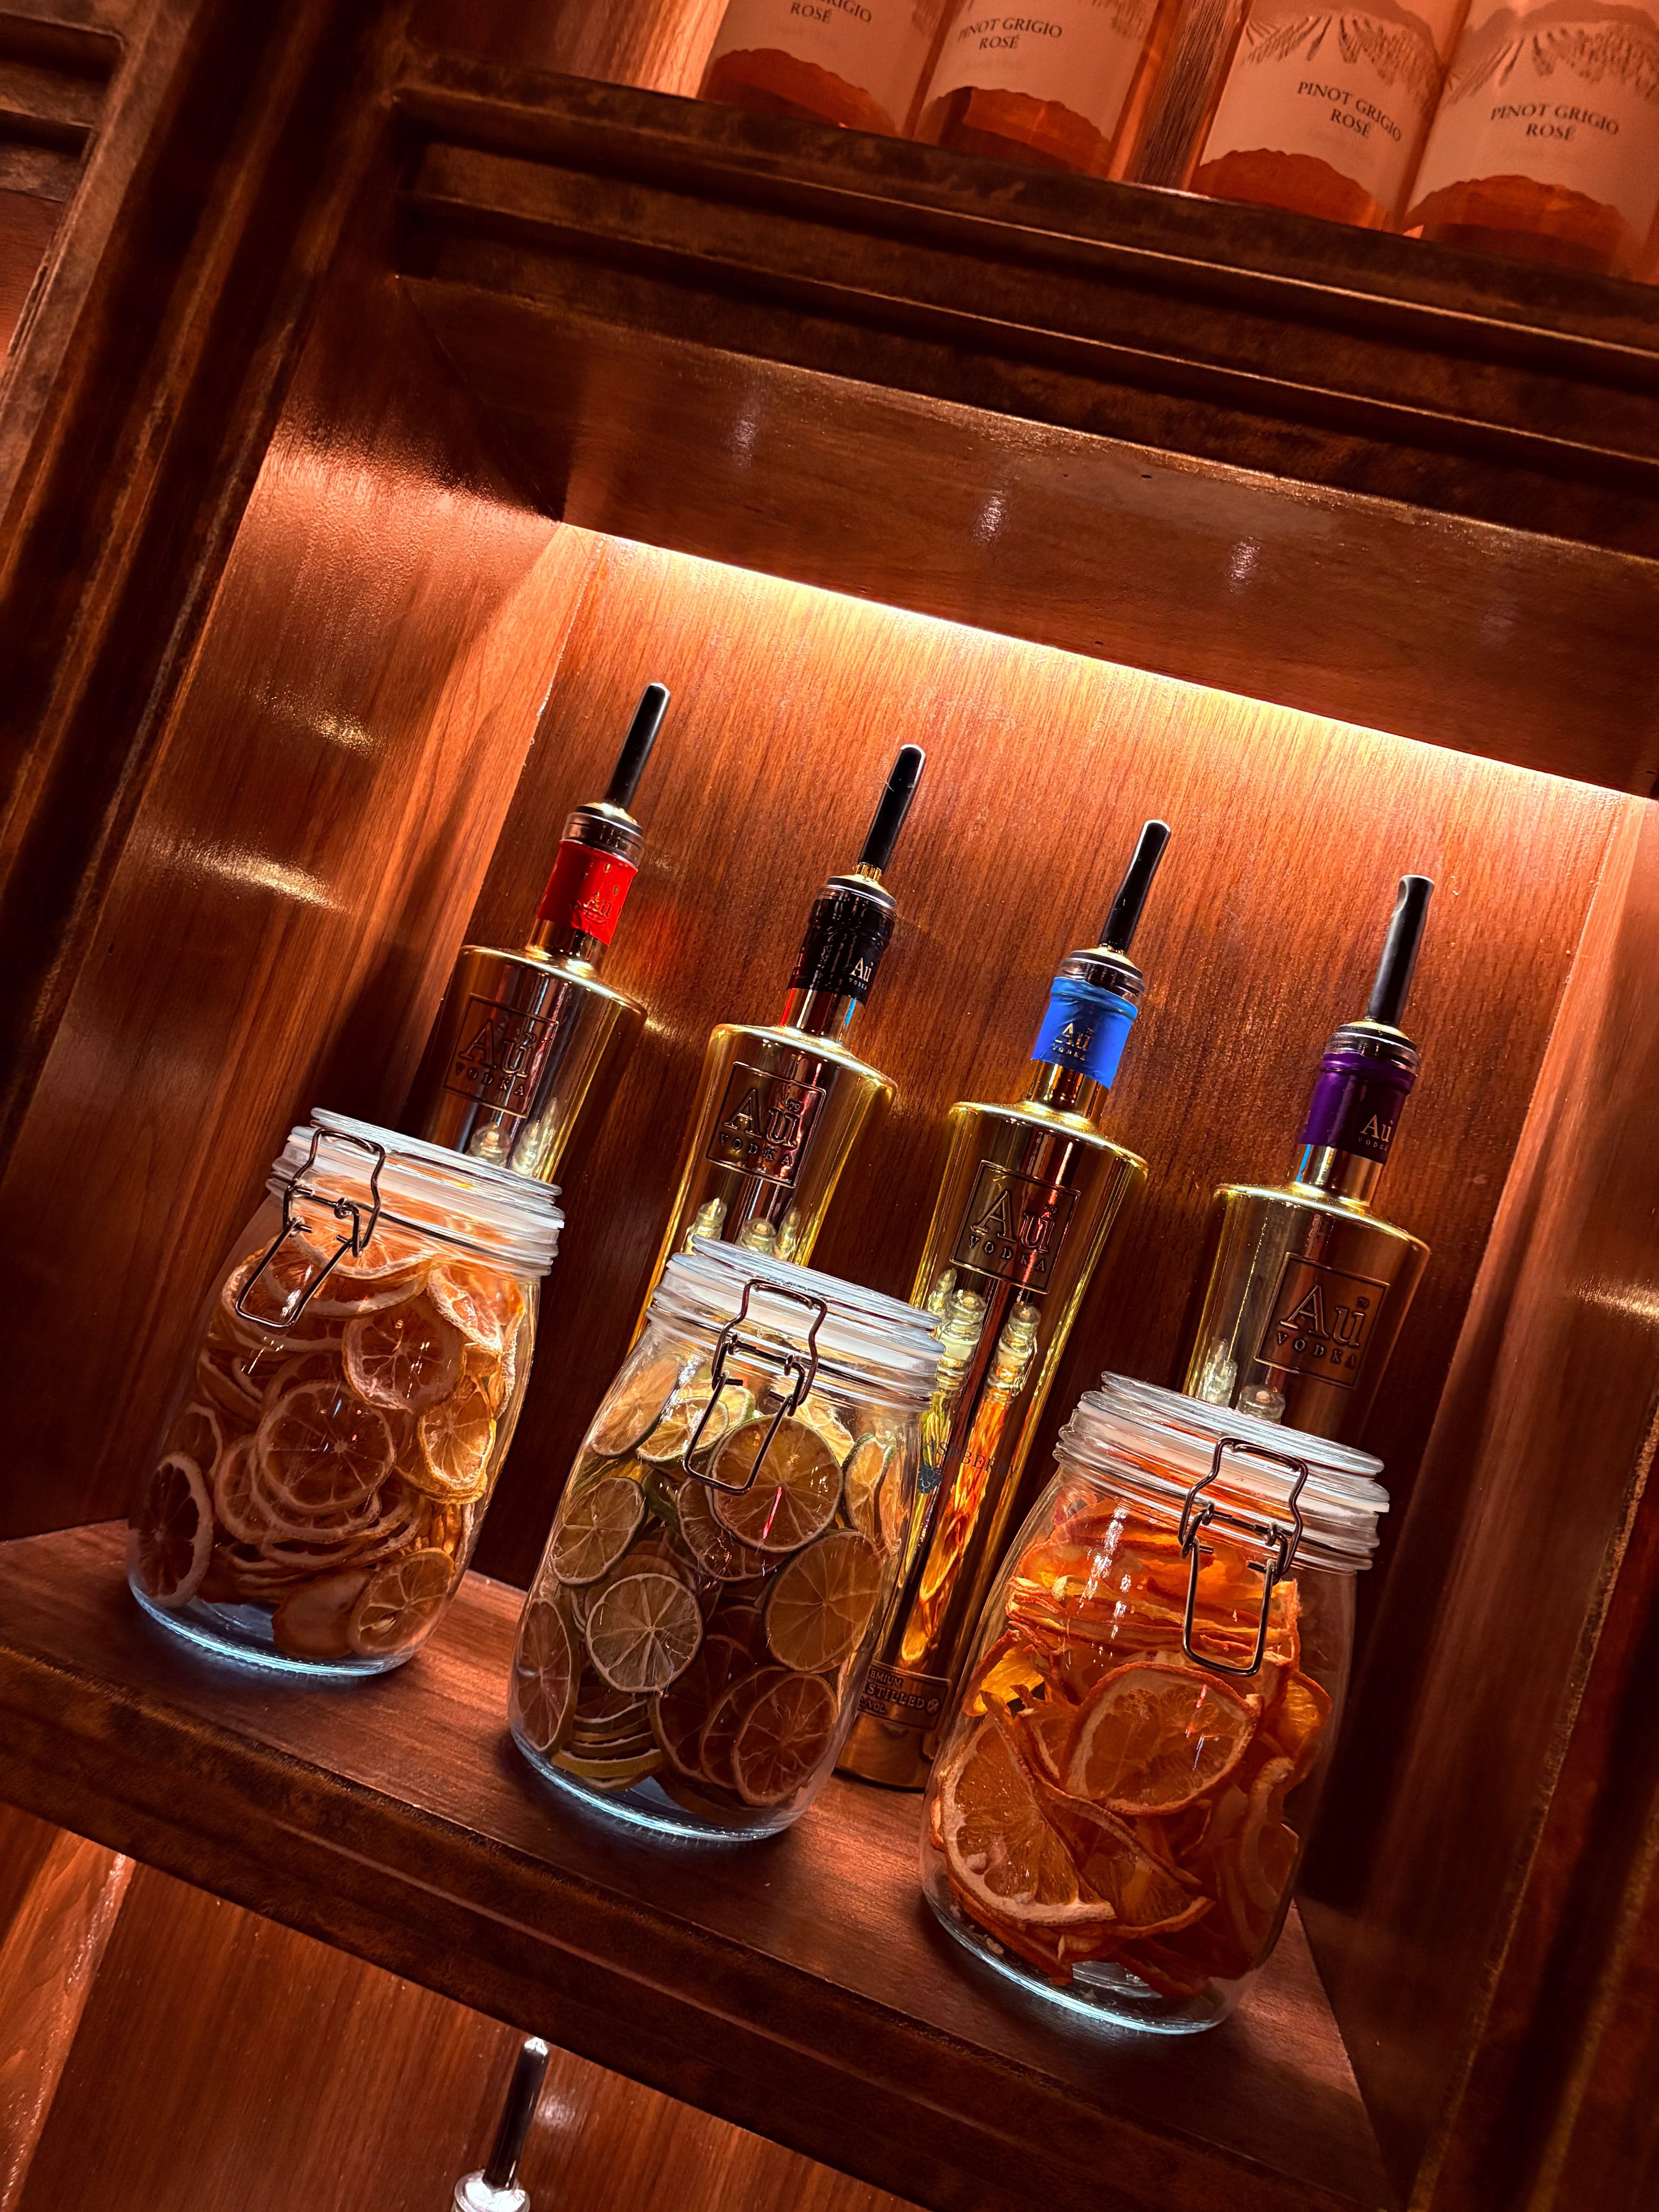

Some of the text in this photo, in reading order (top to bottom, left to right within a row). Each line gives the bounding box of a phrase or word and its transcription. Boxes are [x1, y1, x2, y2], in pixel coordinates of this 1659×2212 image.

[822, 0, 871, 22] IGIO
[1003, 18, 1062, 38] GRIGIO
[1297, 82, 1401, 141] PINOT GRIGIO
[1491, 103, 1618, 135] PINOT GRIGIO
[459, 1019, 531, 1077] Au
[456, 1062, 524, 1096] VODKA
[723, 1089, 800, 1147] Au
[721, 1133, 792, 1166] VODKA
[971, 1190, 1055, 1253] Au
[969, 1236, 1045, 1271] VODKA
[1281, 1284, 1364, 1346] Au
[1278, 1332, 1354, 1367] VODKA
[866, 1683, 925, 1708] STILLED
[869, 1670, 902, 1687] EMIUM
